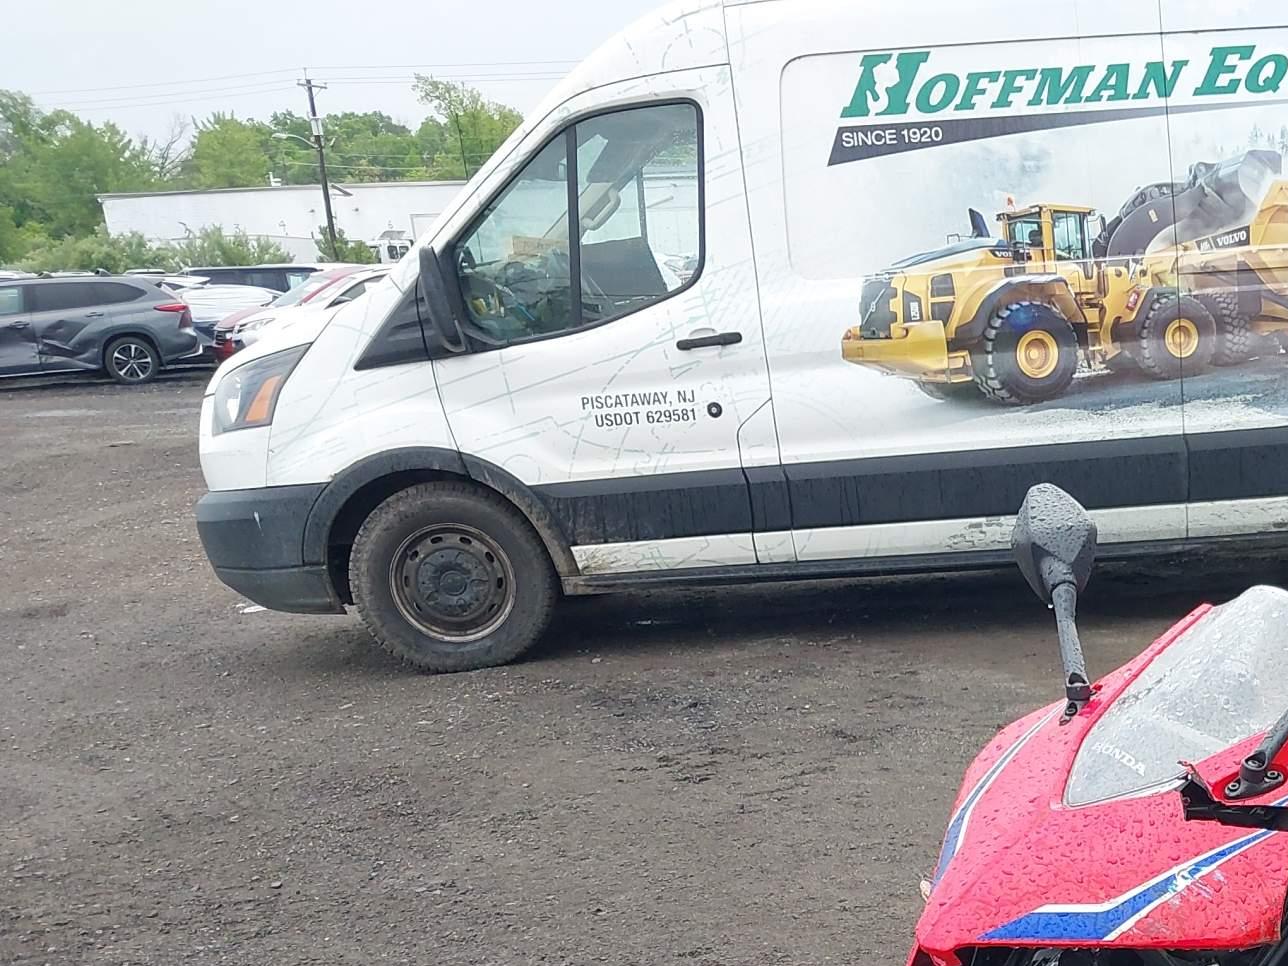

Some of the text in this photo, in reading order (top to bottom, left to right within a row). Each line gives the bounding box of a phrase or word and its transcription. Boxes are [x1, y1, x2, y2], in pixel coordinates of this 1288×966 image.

[840, 51, 1190, 118] HOFFMAN
[841, 126, 943, 148] SINCE 1920
[1216, 230, 1247, 247] VOLVO
[581, 389, 696, 411] PISCATAWAY, NJ
[594, 408, 697, 428] USDOT 629581
[1091, 741, 1145, 777] HONDA
